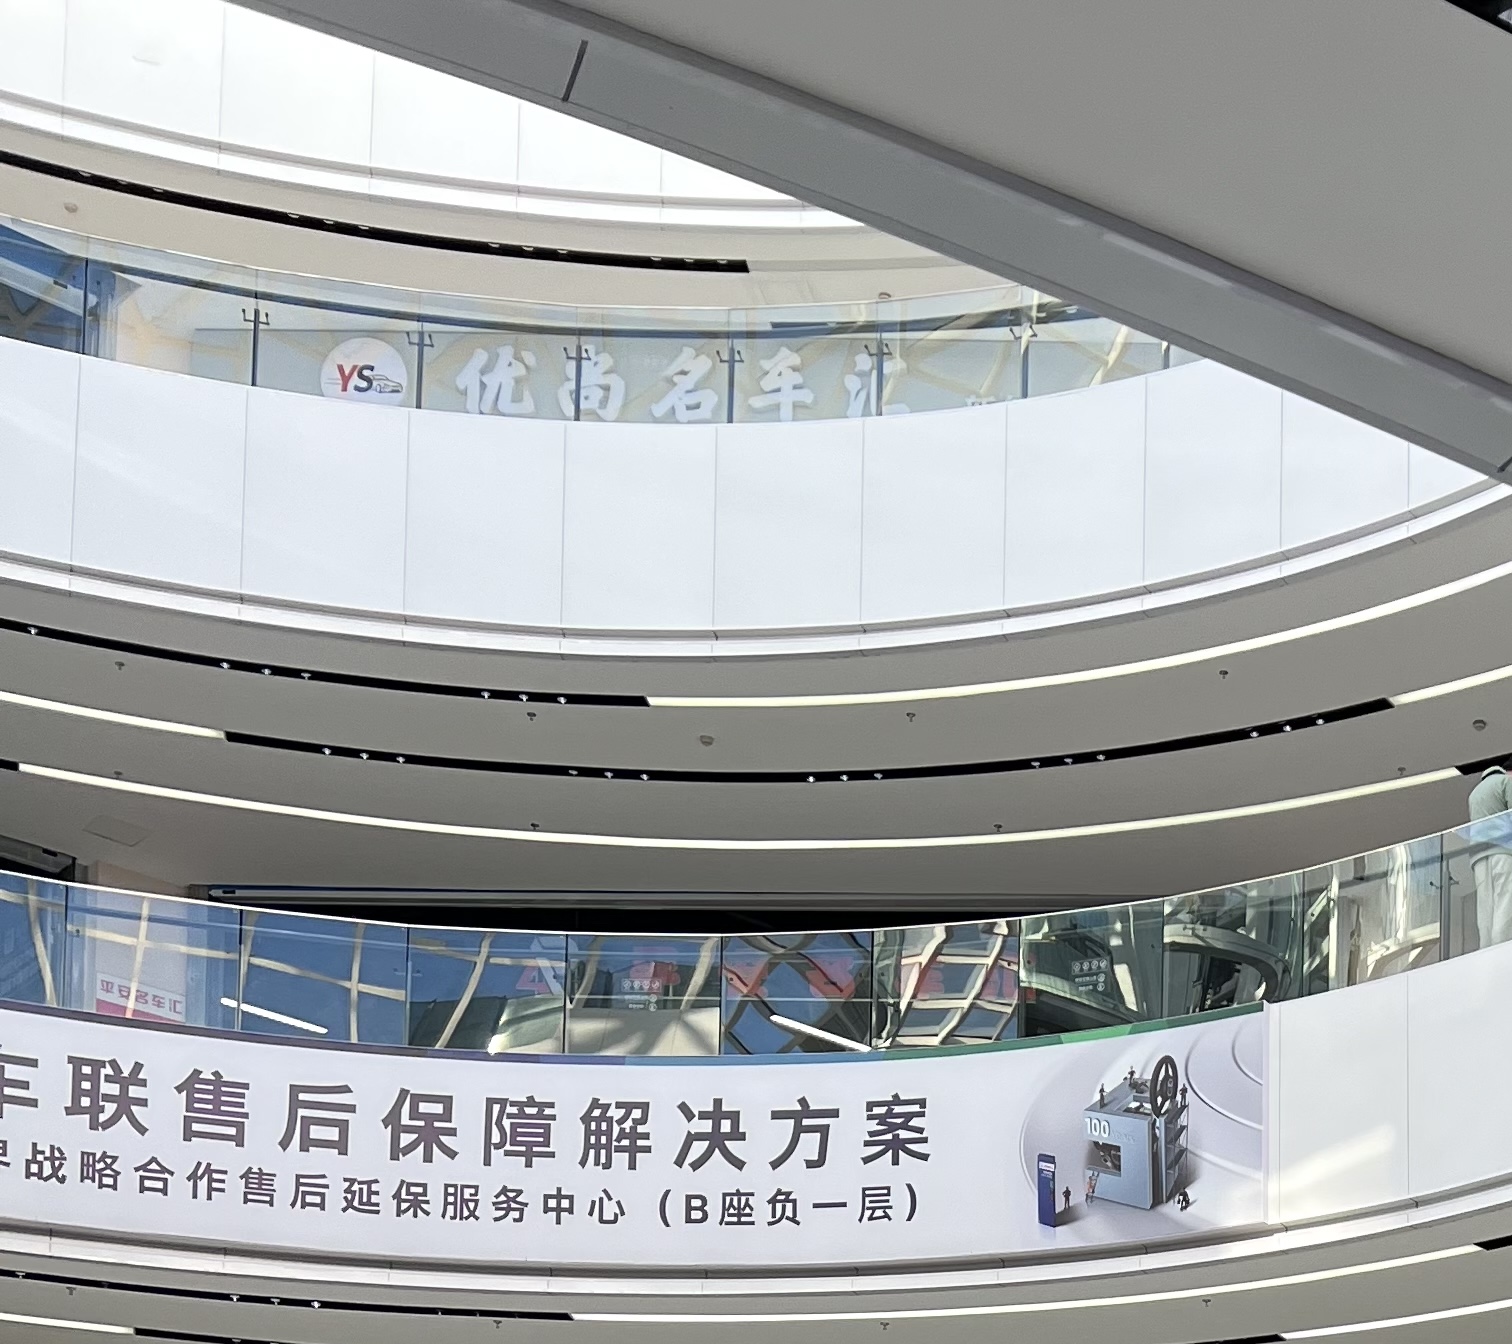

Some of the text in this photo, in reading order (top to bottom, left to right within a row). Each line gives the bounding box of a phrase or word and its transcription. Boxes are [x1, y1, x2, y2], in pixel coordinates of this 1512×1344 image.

[336, 363, 375, 393] YS
[455, 345, 912, 422] 优尚名车汇
[100, 979, 184, 1015] 平安名车汇
[1085, 1117, 1110, 1138] 100
[0, 1139, 918, 1228] 战略合作售后延保服务中心（B座负一层）
